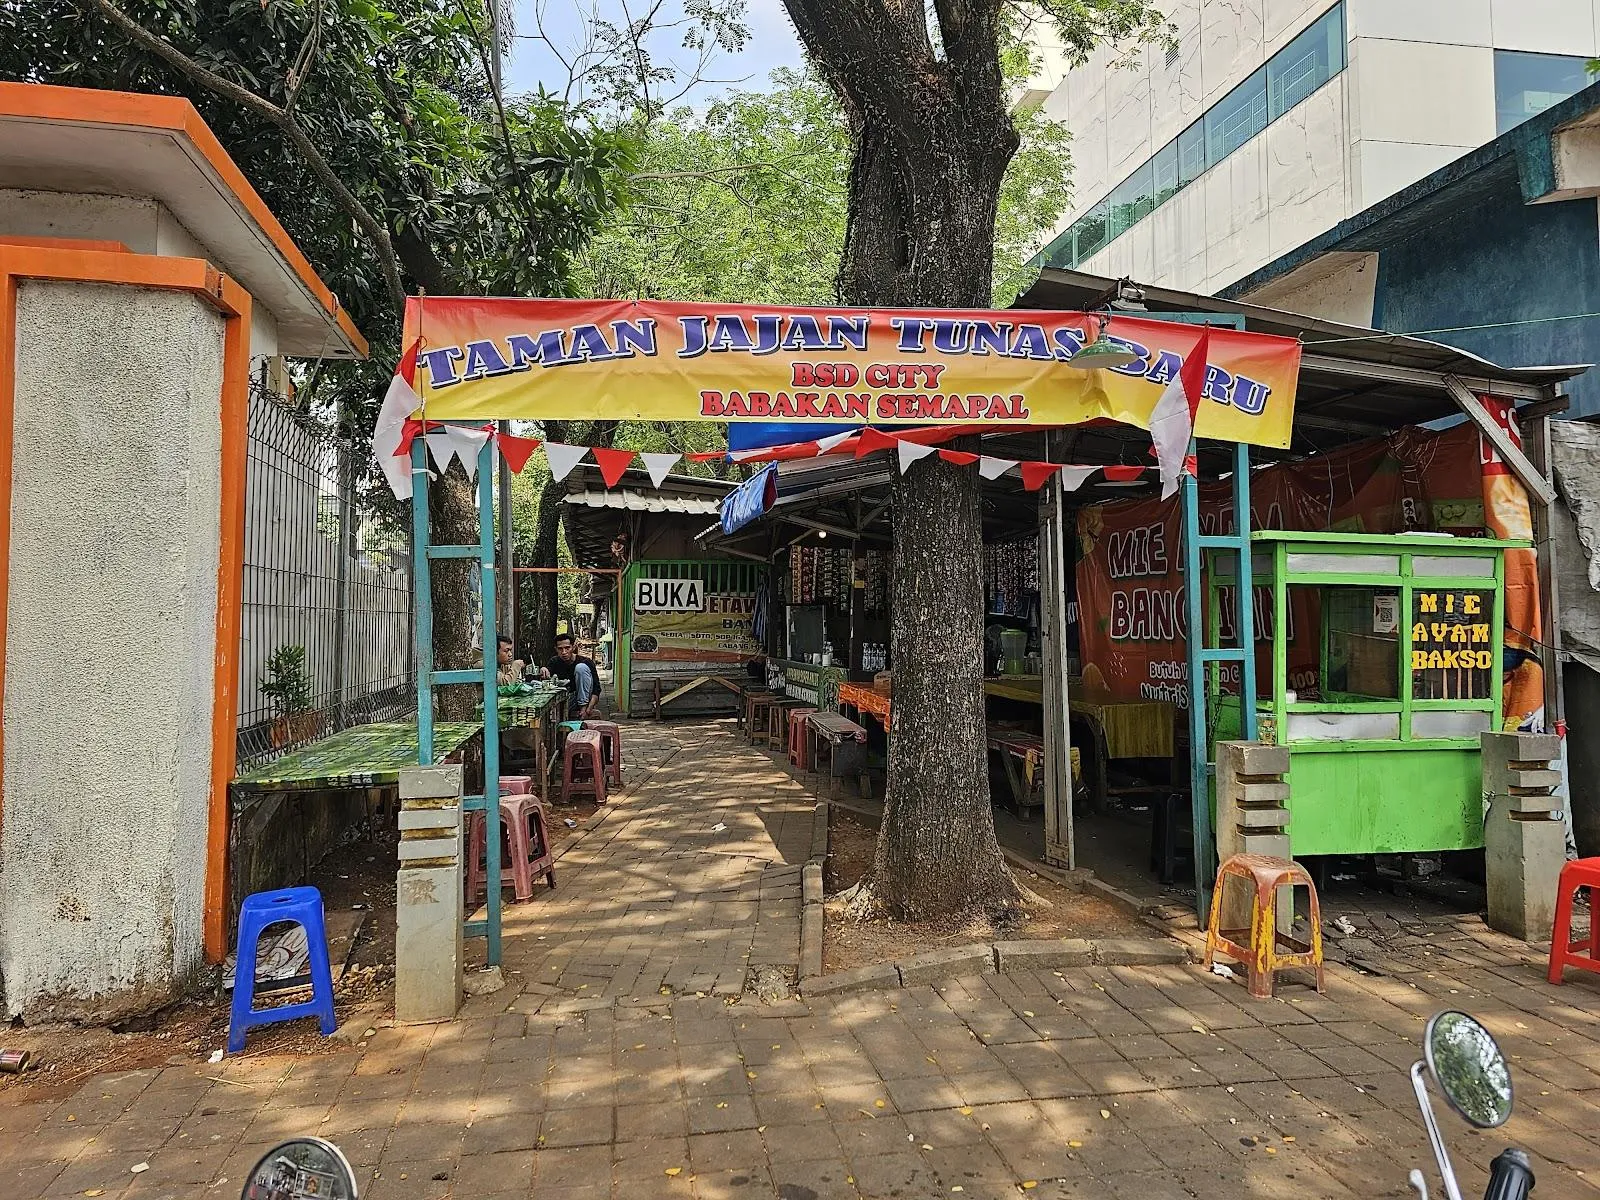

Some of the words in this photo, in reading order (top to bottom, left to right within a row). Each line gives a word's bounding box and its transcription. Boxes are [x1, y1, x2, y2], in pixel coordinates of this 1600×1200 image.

[417, 318, 658, 389] TAMAN
[677, 314, 873, 357] JAJAN
[892, 316, 1087, 363] TUNAS
[791, 363, 860, 389] BSD
[865, 364, 945, 389] CITY
[700, 391, 872, 419] BABAKAN
[876, 395, 1030, 420] SEMAPAL
[1108, 521, 1168, 579] MIE
[638, 582, 699, 608] BUKA
[1420, 593, 1481, 614] MIE
[1412, 622, 1489, 643] AYAM
[1411, 649, 1492, 670] BAKSO
